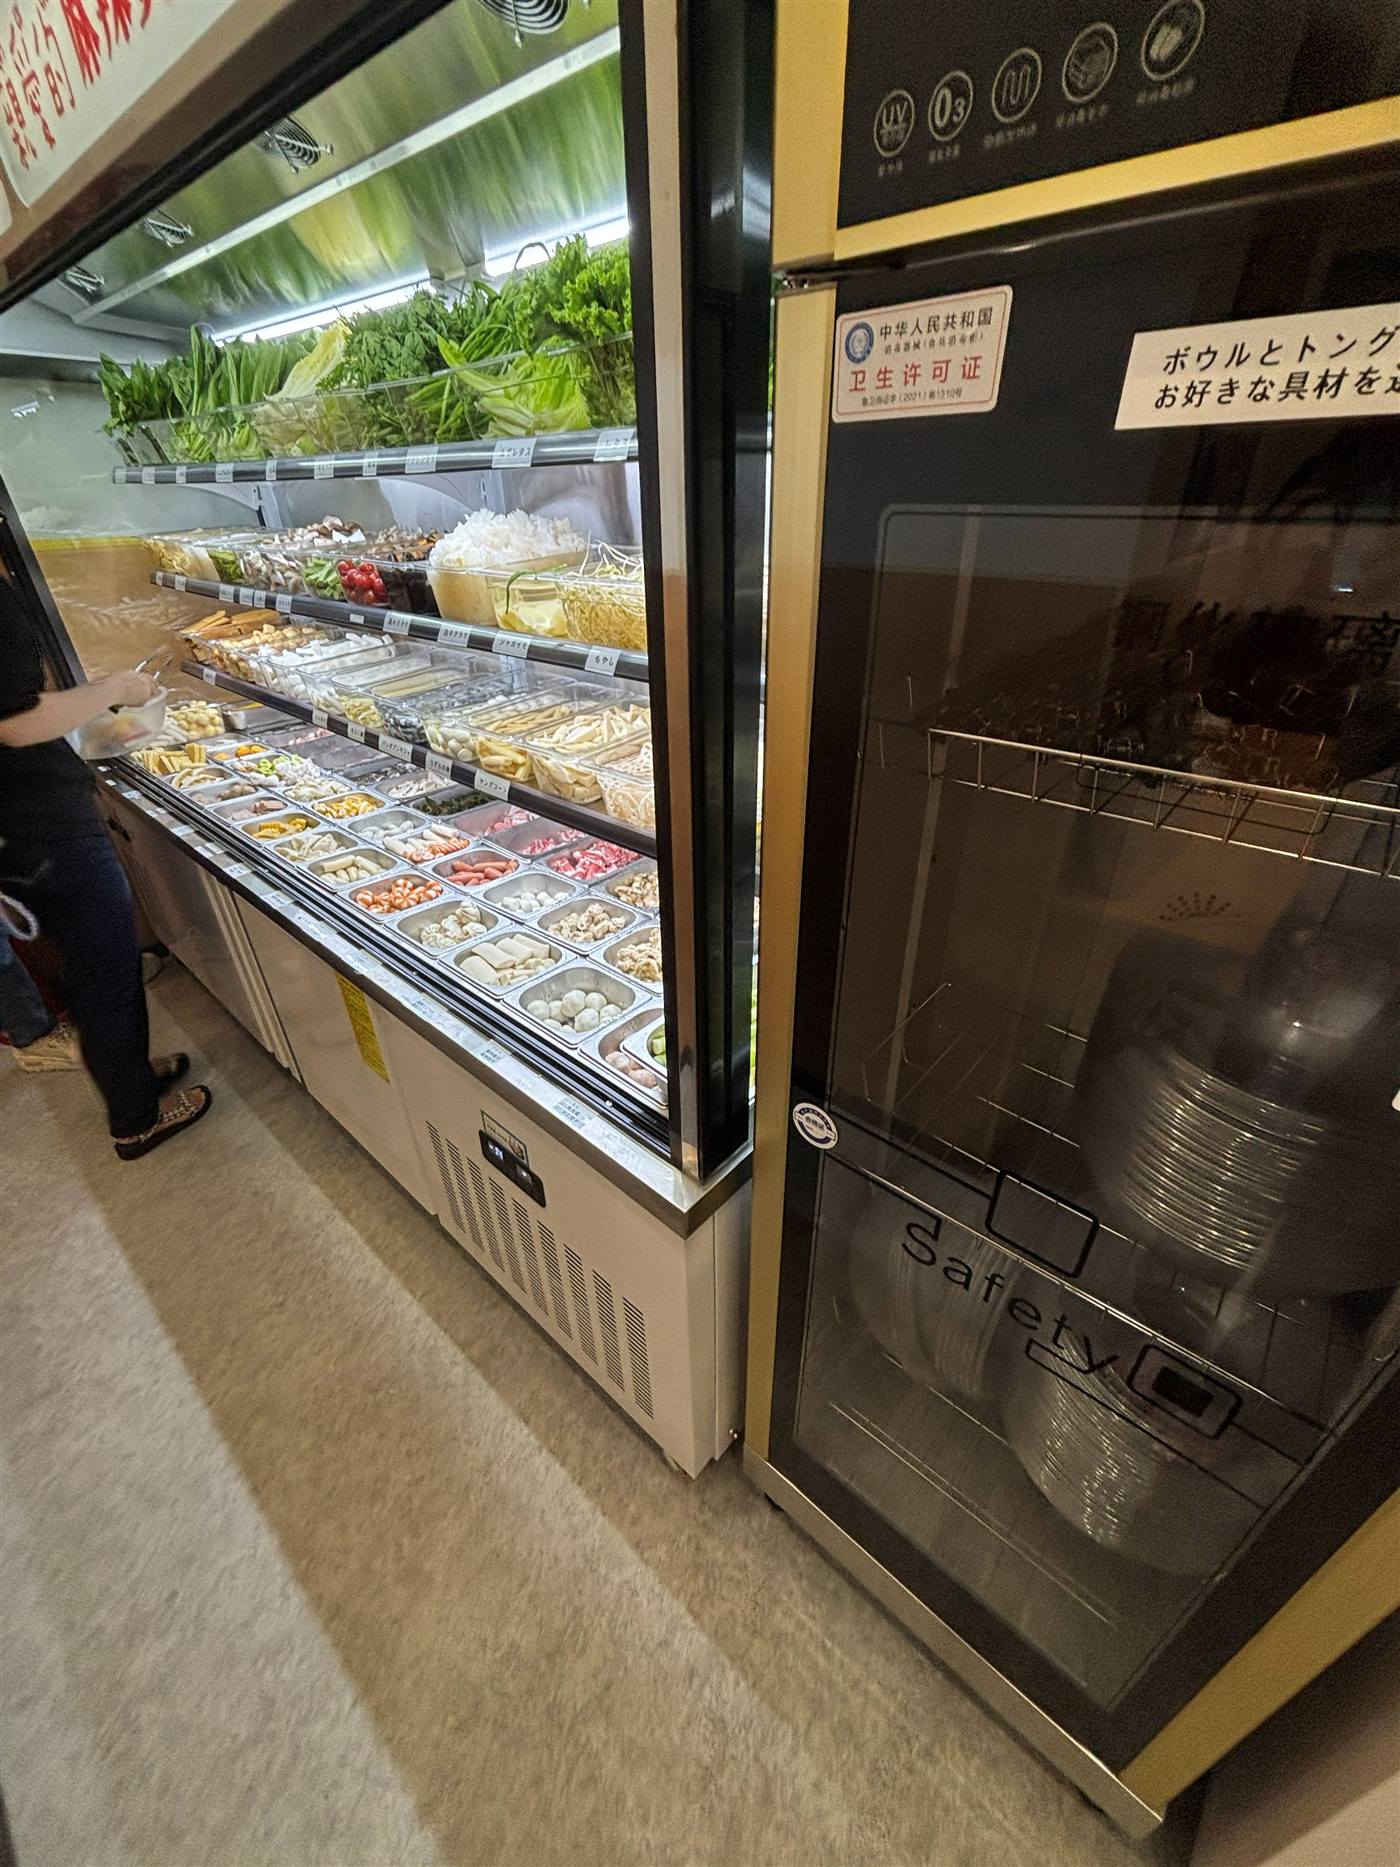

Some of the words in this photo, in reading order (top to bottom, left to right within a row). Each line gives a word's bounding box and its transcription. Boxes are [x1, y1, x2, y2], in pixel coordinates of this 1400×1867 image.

[882, 101, 908, 129] UV
[879, 306, 993, 341] 中华人民共和国
[1162, 325, 1400, 375] ボウルとトング
[849, 355, 983, 393] 卫生许可证
[902, 1218, 1120, 1375] Safety
